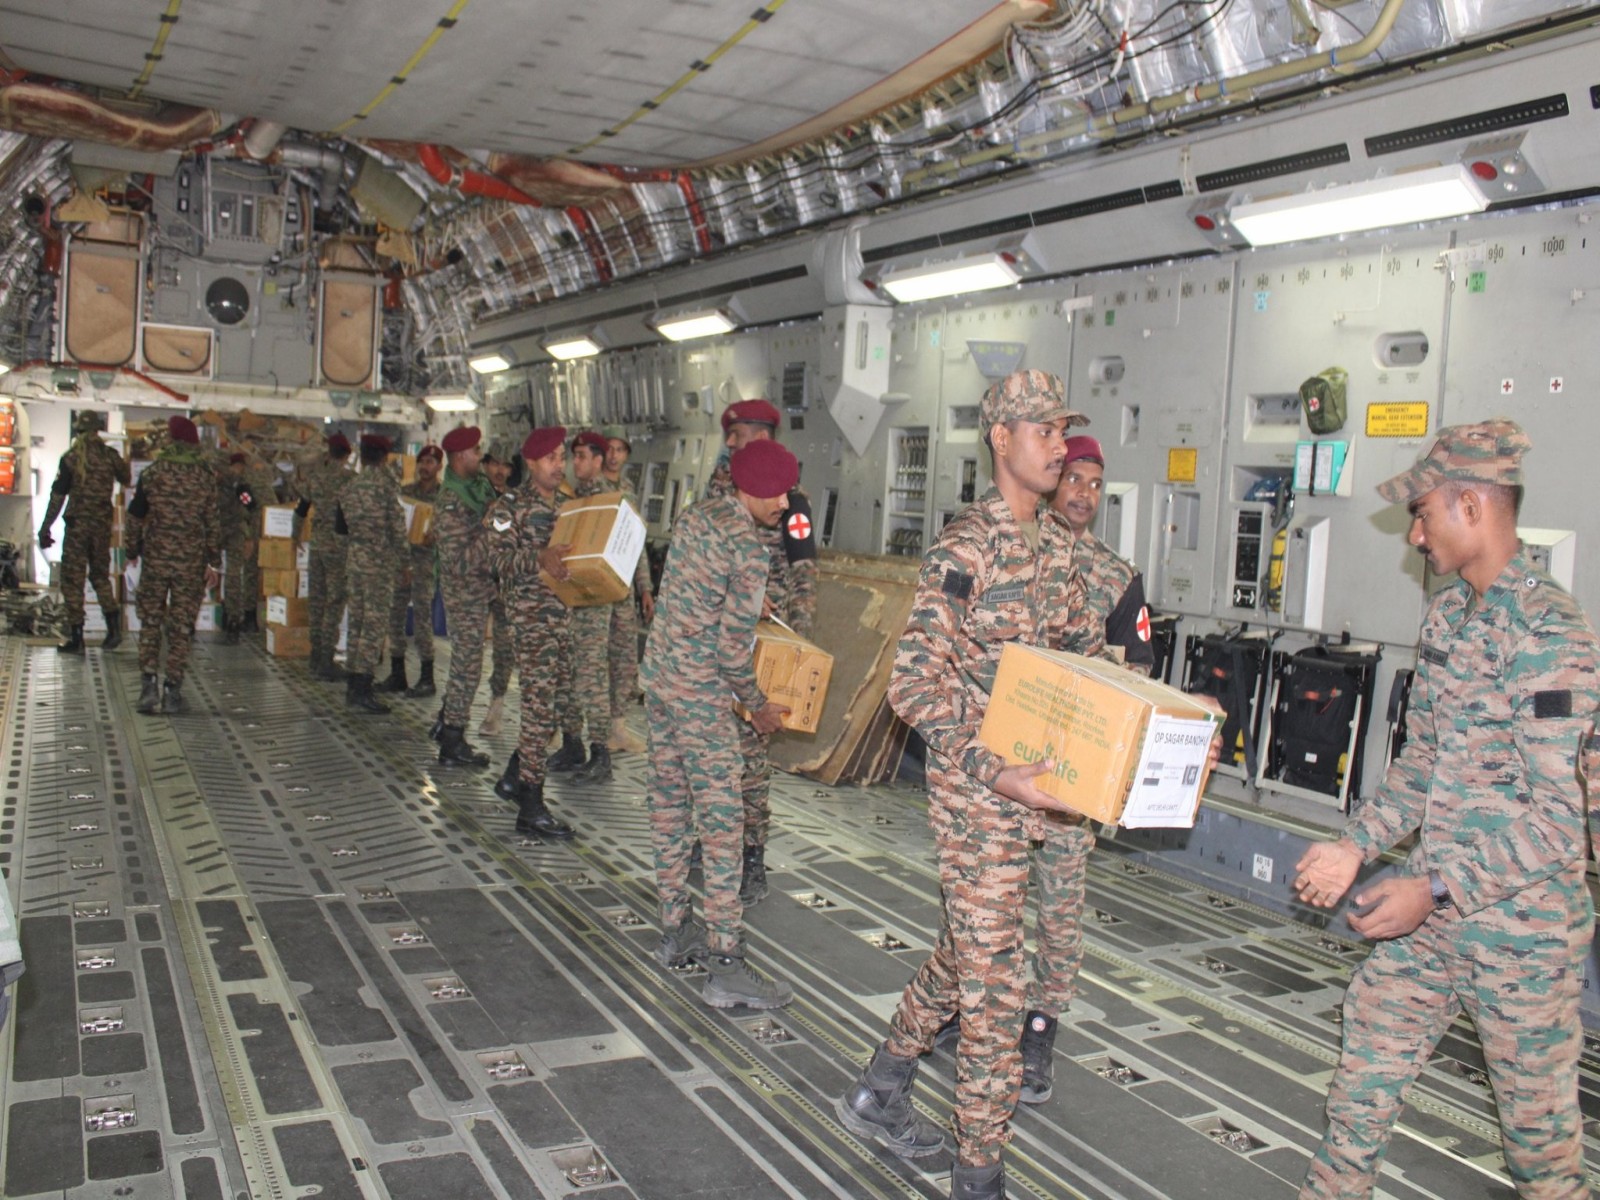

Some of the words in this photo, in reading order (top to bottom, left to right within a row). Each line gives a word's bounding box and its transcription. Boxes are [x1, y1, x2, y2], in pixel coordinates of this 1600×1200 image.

[1543, 239, 1565, 253] 1000
[1488, 247, 1504, 260] 990
[1340, 265, 1354, 277] 960
[1387, 260, 1401, 273] 970
[1154, 732, 1165, 744] OP
[1164, 733, 1184, 745] SAGAR
[1184, 735, 1209, 747] BANDHU
